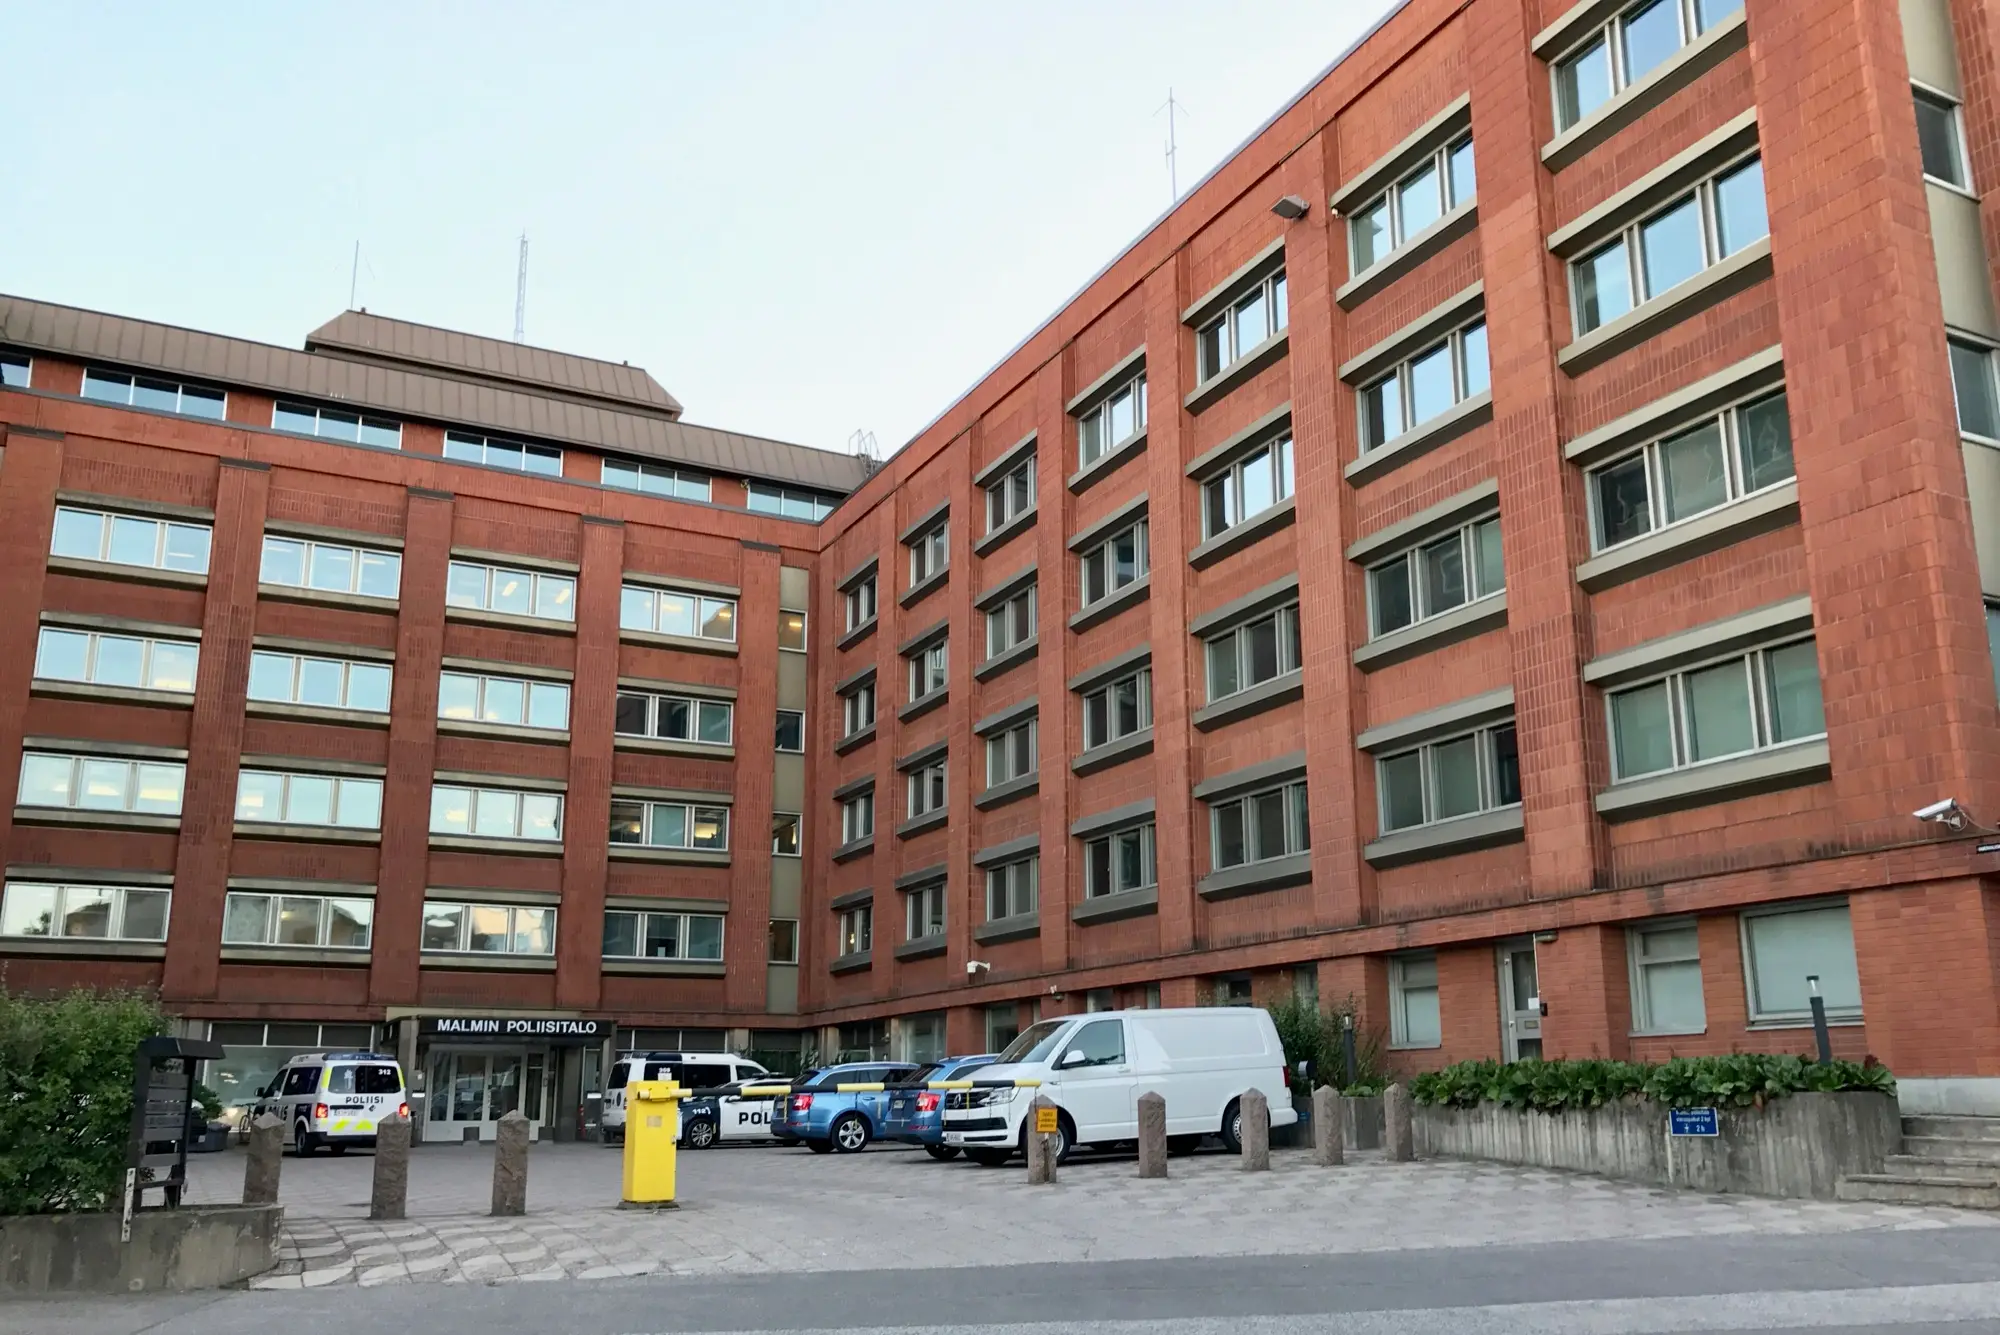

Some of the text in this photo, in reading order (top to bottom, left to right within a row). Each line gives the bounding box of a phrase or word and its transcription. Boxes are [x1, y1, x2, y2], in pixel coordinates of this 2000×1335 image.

[437, 1019, 597, 1033] MALMIN POLIISITALO
[346, 1096, 383, 1104] POLIISI
[739, 1112, 772, 1125] POL
[1696, 1124, 1700, 1132] 2
